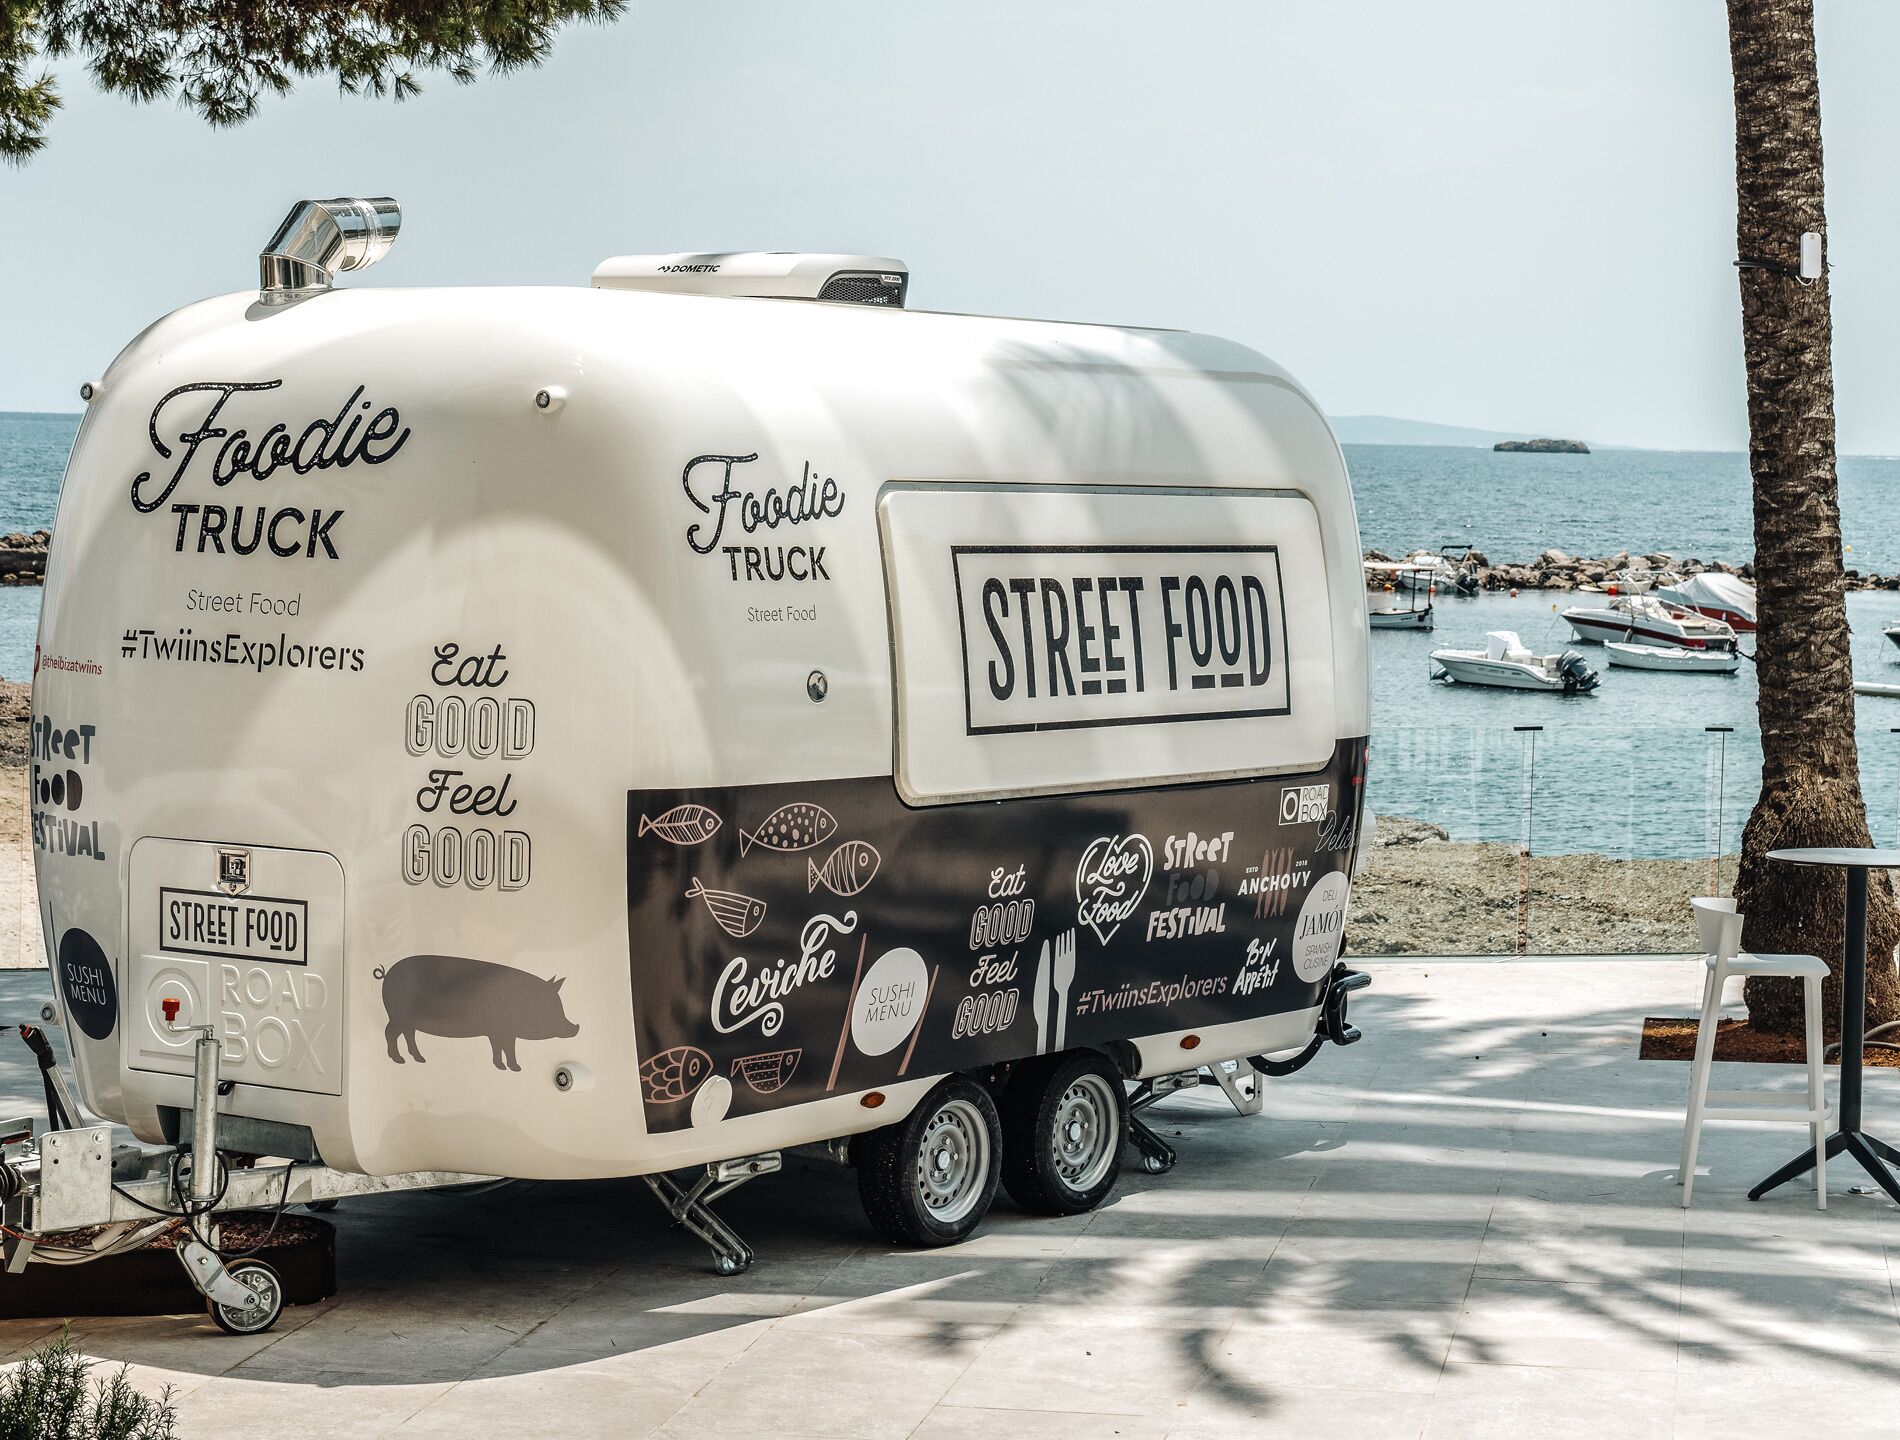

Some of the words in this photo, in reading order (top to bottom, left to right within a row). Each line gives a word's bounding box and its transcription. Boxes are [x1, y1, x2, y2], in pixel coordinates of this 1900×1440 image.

[671, 265, 720, 273] DOMETIC
[131, 379, 411, 513] Foodie
[683, 453, 844, 554] Foodie
[171, 504, 344, 560] TRUCK
[722, 547, 830, 581] TRUCK
[187, 589, 242, 615] Street
[249, 593, 301, 617] Food
[747, 606, 783, 622] Street
[787, 604, 817, 621] Food
[121, 629, 364, 673] #TwiinsExplorers
[982, 576, 1145, 702] STREET
[1161, 575, 1272, 691] FOOD
[42, 654, 102, 676] @theibizatwiins
[431, 643, 508, 687] Eat
[405, 694, 535, 760] GOOD
[416, 769, 517, 817] Feel
[1302, 803, 1328, 822] BOX
[1303, 785, 1328, 801] ROAD
[401, 824, 531, 892] GOOD
[1087, 834, 1139, 885] Love
[988, 863, 1026, 898] Eat
[1237, 870, 1311, 896] ANCHOVY
[1322, 889, 1338, 902] DELI
[969, 898, 1035, 951] GOOD
[1078, 881, 1139, 926] Food
[1299, 904, 1344, 940] JAMÓN
[170, 900, 238, 946] STREET
[246, 908, 298, 952] FOOD
[969, 950, 1019, 987] Feel
[1305, 941, 1333, 957] SPANISH
[67, 963, 103, 986] SUSHI
[220, 964, 328, 1012] ROAD
[711, 910, 857, 1036] Ceviche
[869, 981, 915, 1006] SUSHI
[70, 983, 106, 1006] MENU
[865, 1001, 913, 1023] MENU
[952, 988, 1020, 1040] GOOD
[1076, 974, 1228, 1016] #TwiinsExplorers
[219, 1010, 325, 1075] BOX
